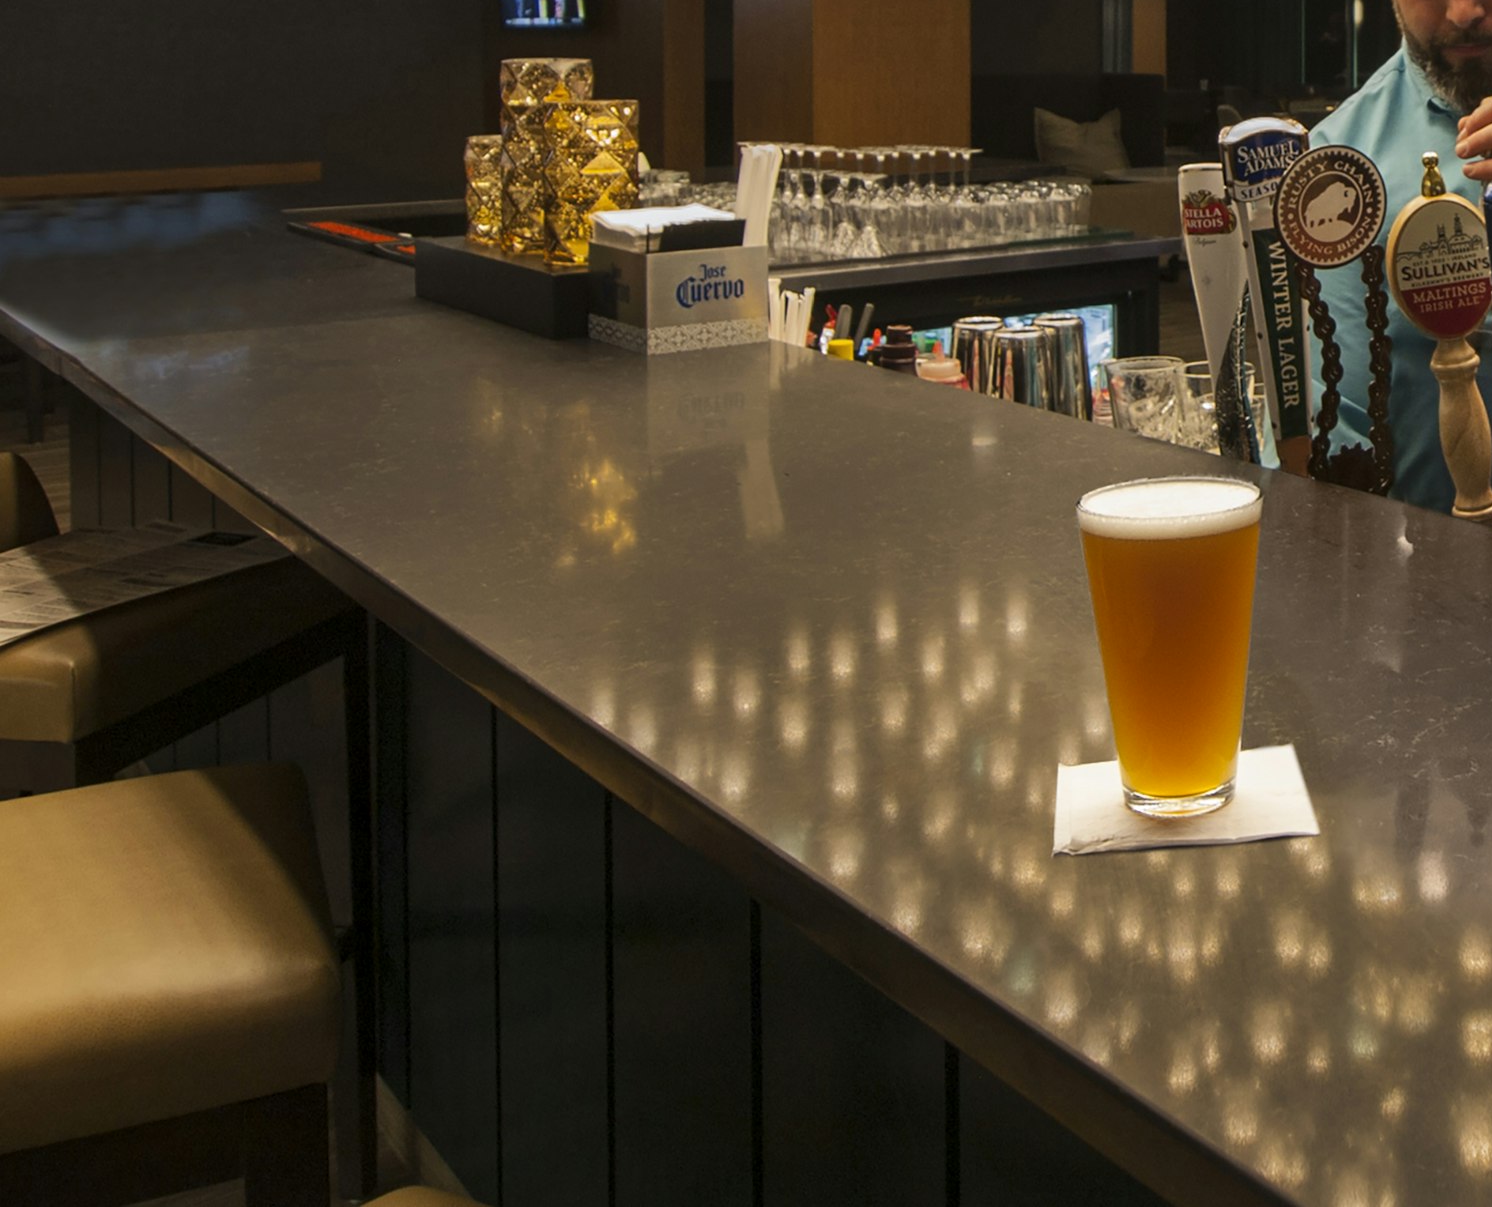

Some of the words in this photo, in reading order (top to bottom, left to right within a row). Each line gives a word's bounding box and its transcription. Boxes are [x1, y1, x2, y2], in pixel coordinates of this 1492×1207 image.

[1237, 139, 1300, 164] SAMUEL
[1244, 154, 1294, 177] ADAMS
[1241, 181, 1281, 199] SEASO
[1287, 160, 1329, 210] RUSTY
[1334, 159, 1374, 204] CHAIN
[1184, 207, 1222, 219] STELLA
[1186, 217, 1224, 229] ARTOIS
[1288, 221, 1333, 255] FLYING
[1336, 216, 1372, 253] BISON
[700, 263, 727, 281] Jose
[1401, 257, 1490, 281] SULLIVAN'S
[675, 276, 745, 309] Cuervo
[1268, 241, 1293, 332] WINTER
[1412, 281, 1487, 304] MALTINGS
[1420, 300, 1453, 313] IRISH
[1278, 338, 1300, 410] LAGER
